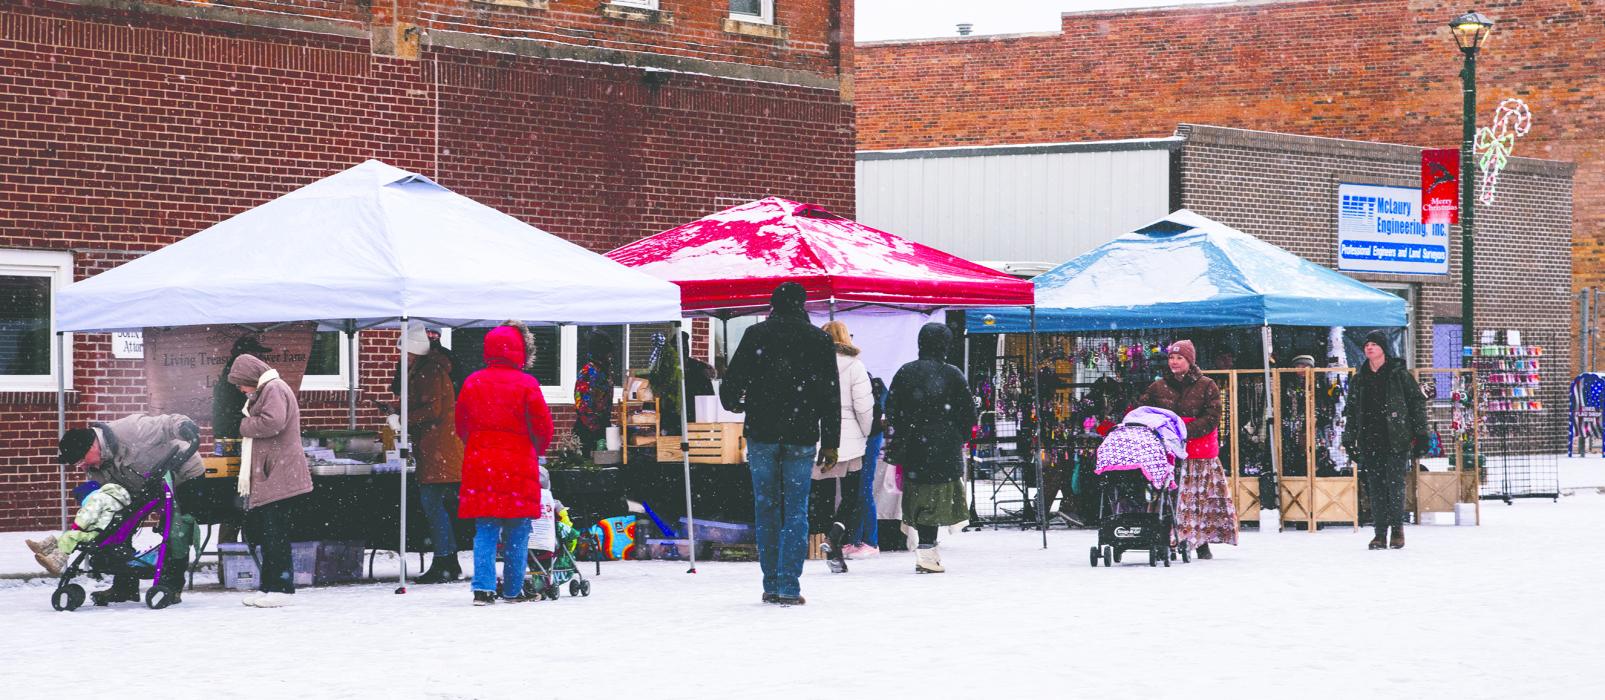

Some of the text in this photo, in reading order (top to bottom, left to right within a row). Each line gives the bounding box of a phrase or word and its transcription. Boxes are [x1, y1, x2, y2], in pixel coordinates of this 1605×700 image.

[1377, 197, 1411, 216] McLaury
[1431, 198, 1452, 206] Merry
[1342, 244, 1445, 261] Professional Engineers and Land Surveyors
[163, 353, 195, 369] Living
